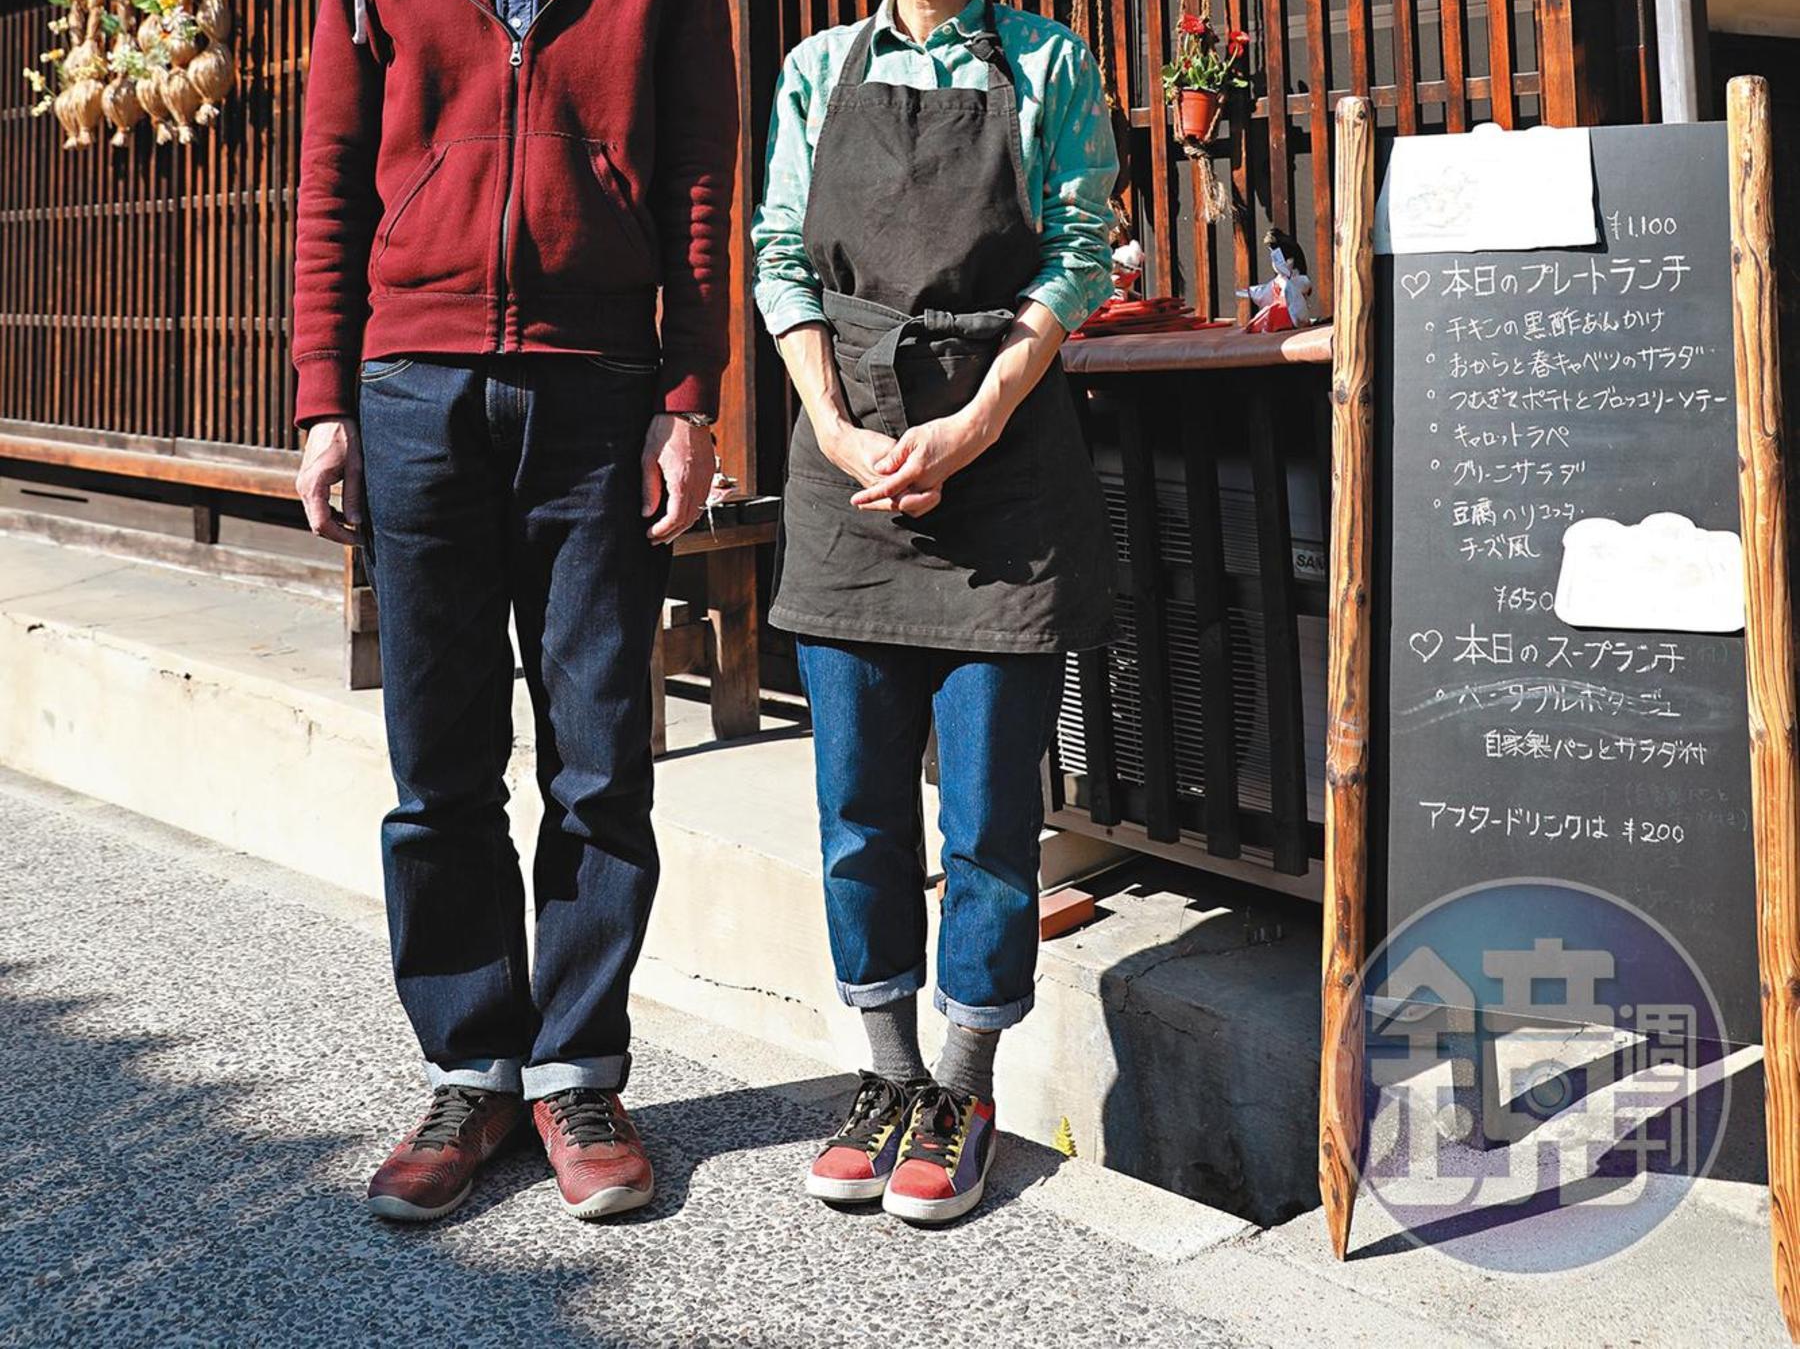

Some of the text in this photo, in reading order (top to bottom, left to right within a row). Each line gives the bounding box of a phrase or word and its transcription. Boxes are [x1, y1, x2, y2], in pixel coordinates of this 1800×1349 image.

[1441, 255, 1691, 298] 本日のプレートランチ
[1446, 307, 1664, 342] チキンの黒酢あんかけ
[1449, 345, 1704, 378] おからと春キャベツのサラダ
[1454, 422, 1570, 448] キャロットラペ
[1453, 458, 1586, 486] グリーンサラダ
[1459, 534, 1540, 561] チーズ風
[1493, 585, 1554, 613] ¥650
[1453, 623, 1685, 673] 本日のスープランチ
[1484, 729, 1708, 768] 自家製パンとサラダ付
[1419, 801, 1608, 840] アフタードリンクは
[1622, 817, 1685, 843] ¥200
